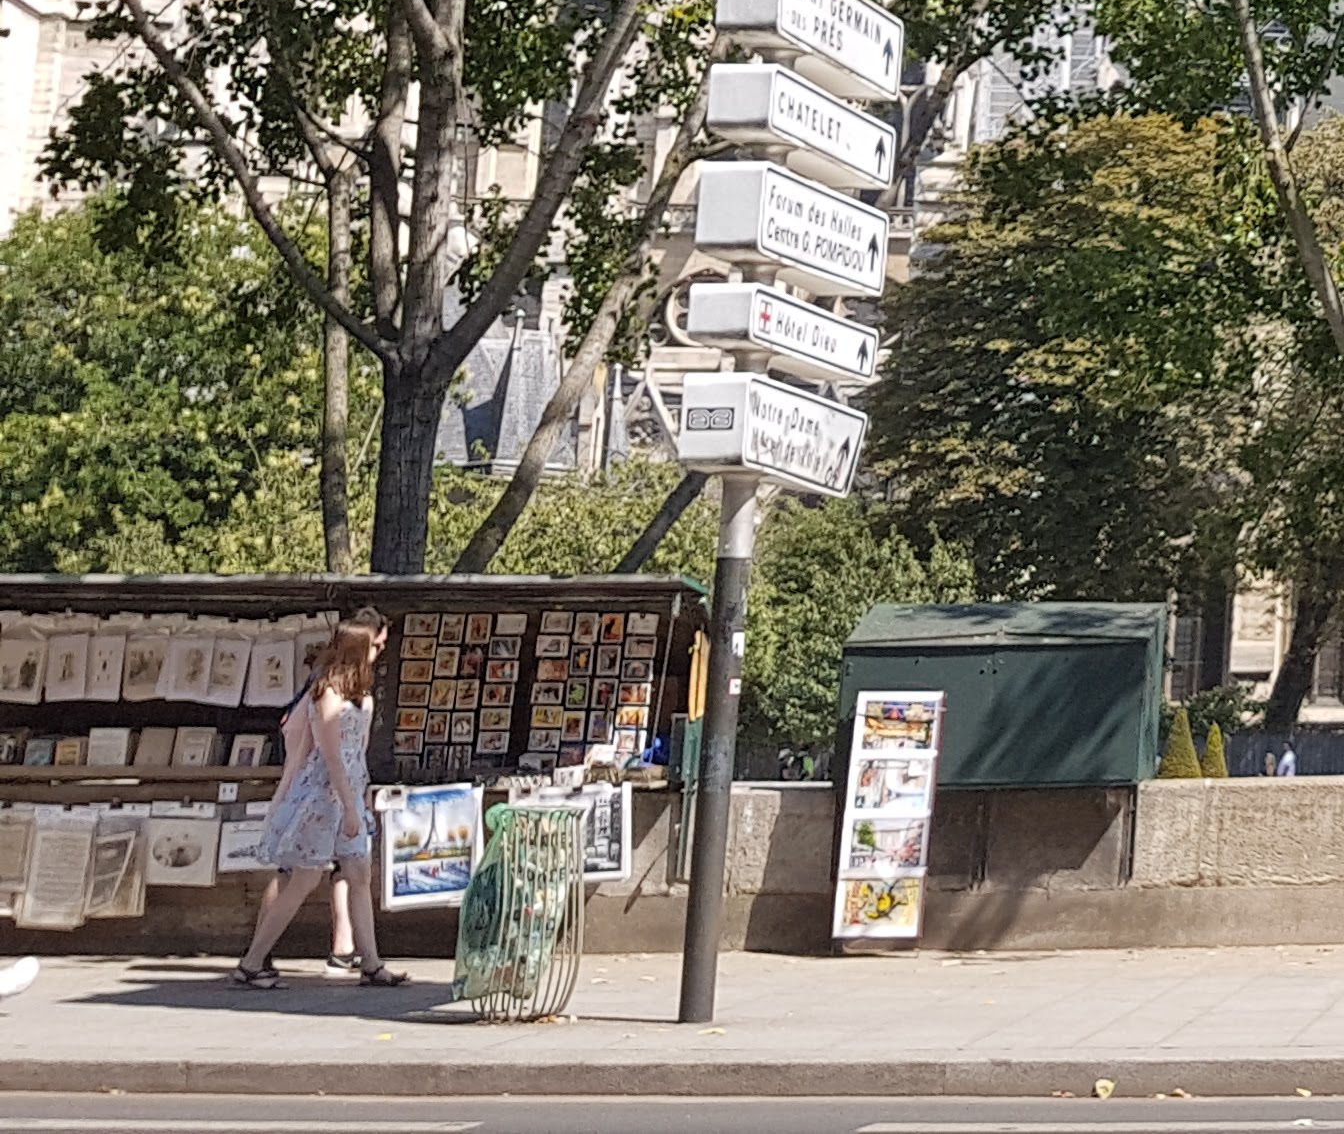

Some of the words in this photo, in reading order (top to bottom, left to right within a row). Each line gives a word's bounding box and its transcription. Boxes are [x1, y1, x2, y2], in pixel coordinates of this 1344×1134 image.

[813, 15, 844, 52] PRÉS
[778, 91, 842, 145] CHATELET
[769, 184, 804, 219] Forum
[808, 201, 827, 227] des
[830, 208, 863, 242] Halles
[766, 216, 800, 250] Centre
[814, 234, 866, 273] POMPIDOU
[775, 310, 809, 344] Hôtel
[812, 323, 838, 354] Dieu
